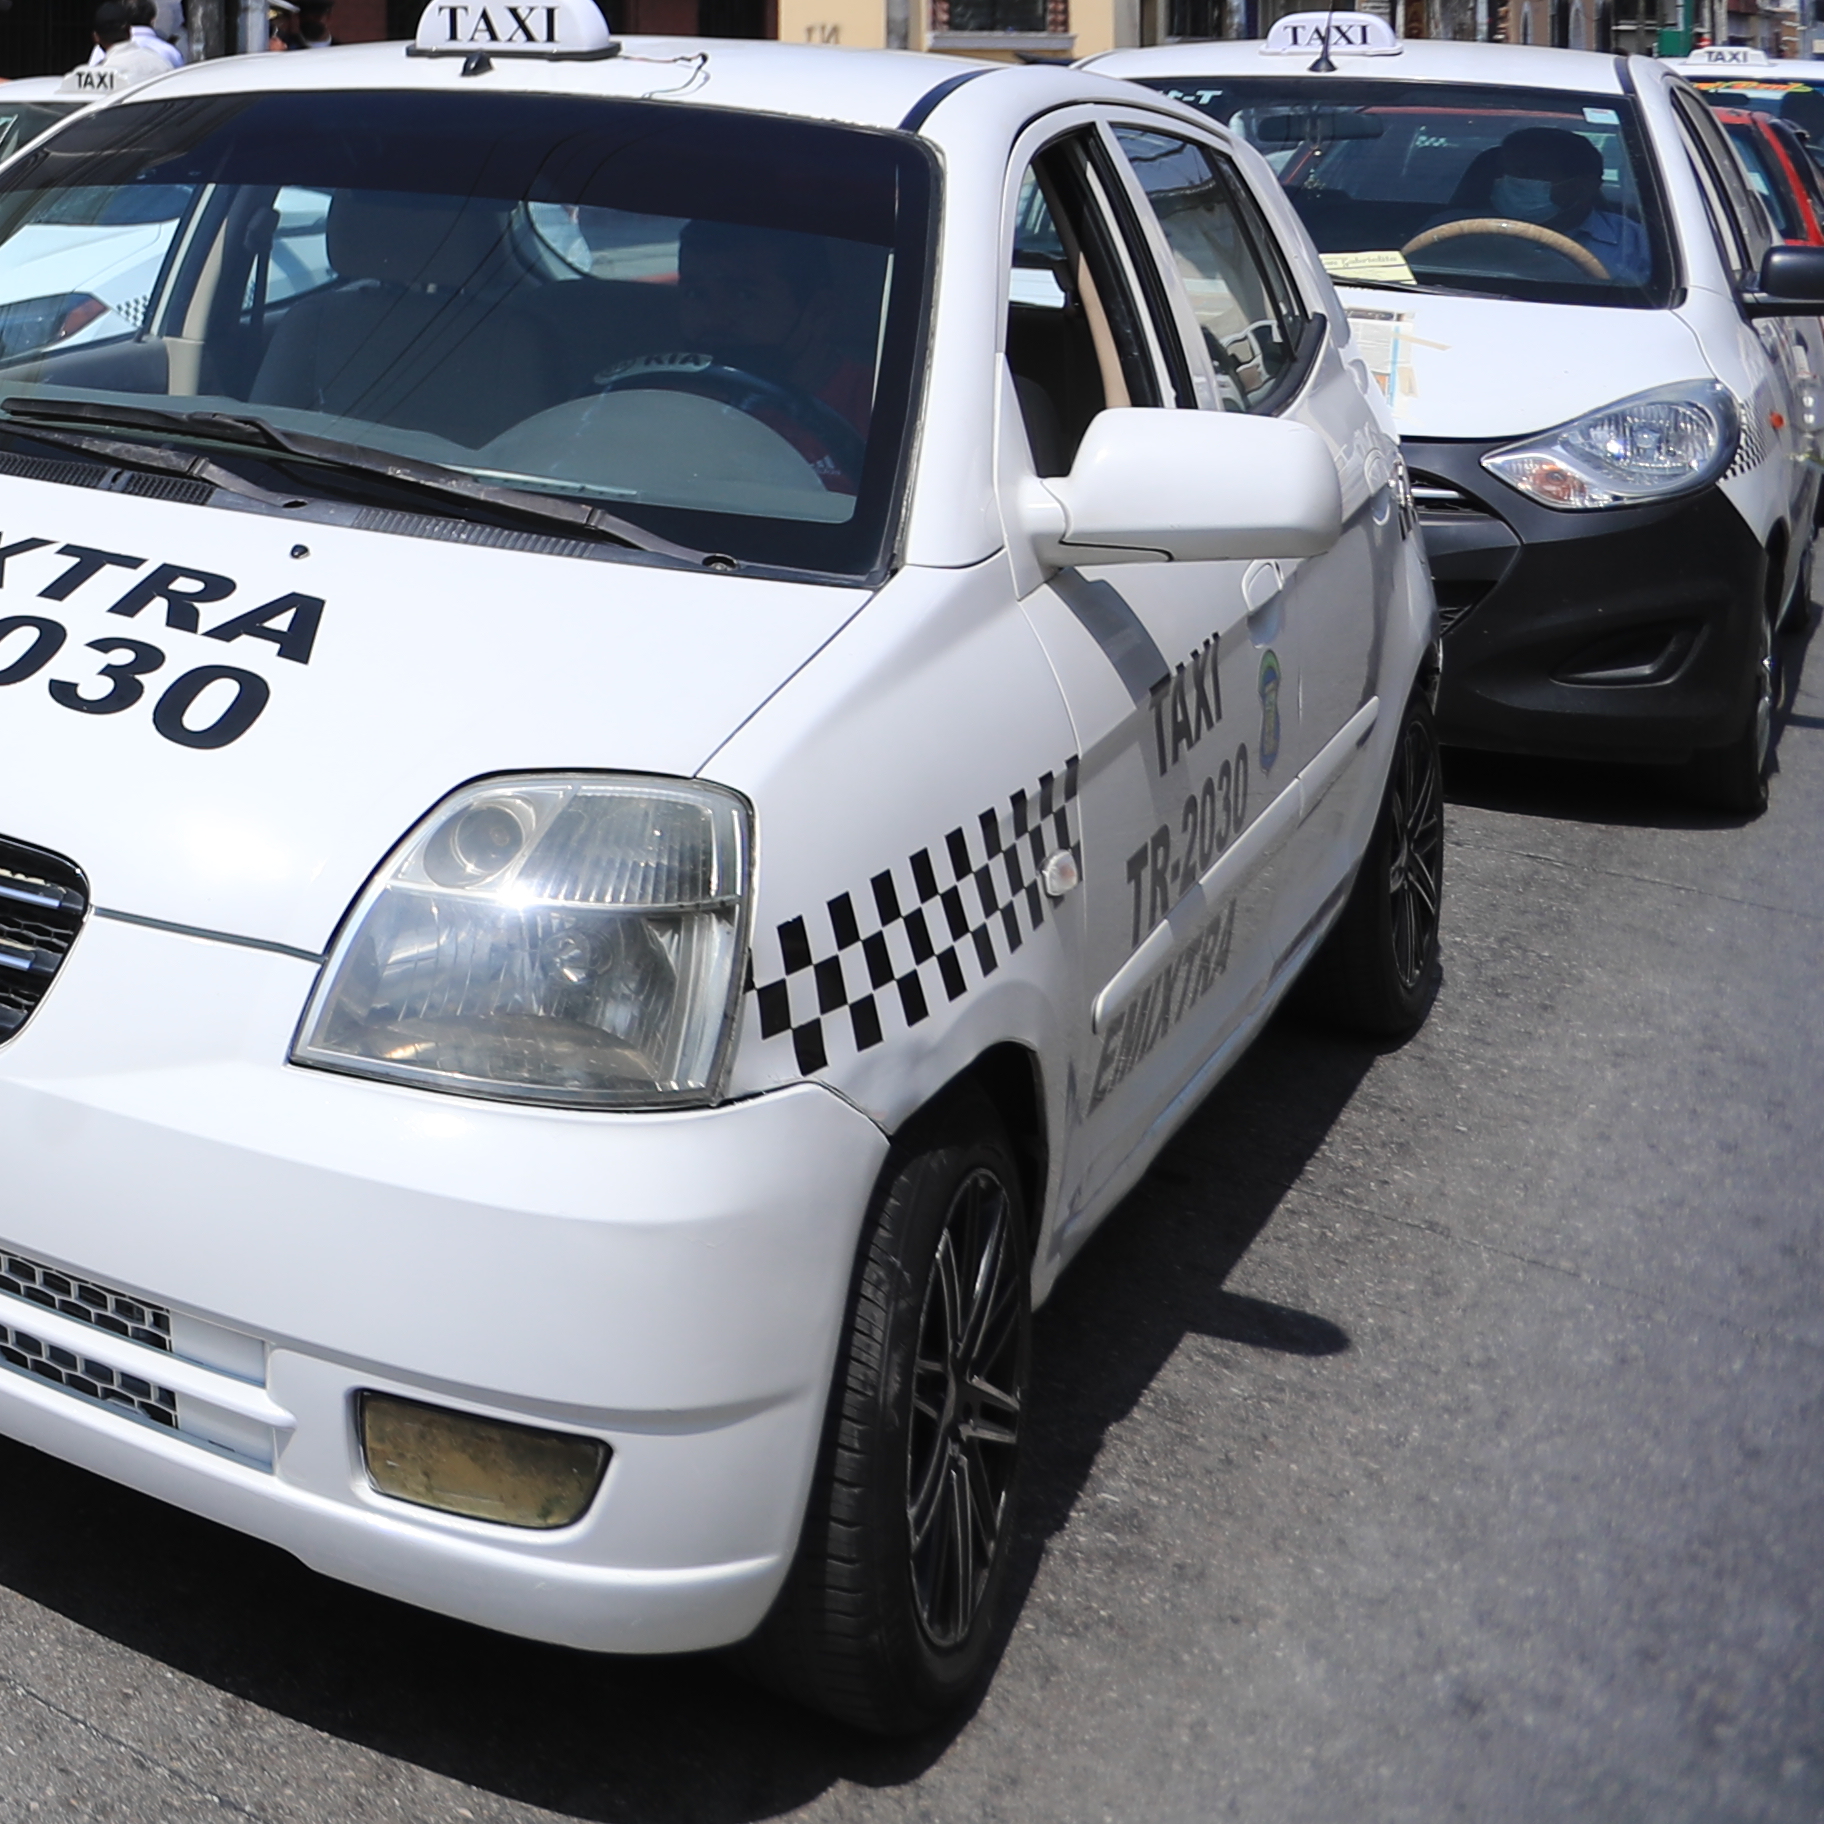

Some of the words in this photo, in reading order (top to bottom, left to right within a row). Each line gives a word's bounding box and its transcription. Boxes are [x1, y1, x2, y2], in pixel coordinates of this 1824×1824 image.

[437, 5, 561, 43] TAXI
[1282, 24, 1371, 46] TAXI
[1705, 51, 1749, 63] TAXI
[76, 71, 115, 90] TAXI
[1148, 632, 1223, 778] TAXI
[1126, 742, 1249, 950] TR-2030
[1086, 897, 1237, 1119] EMIXTRA
